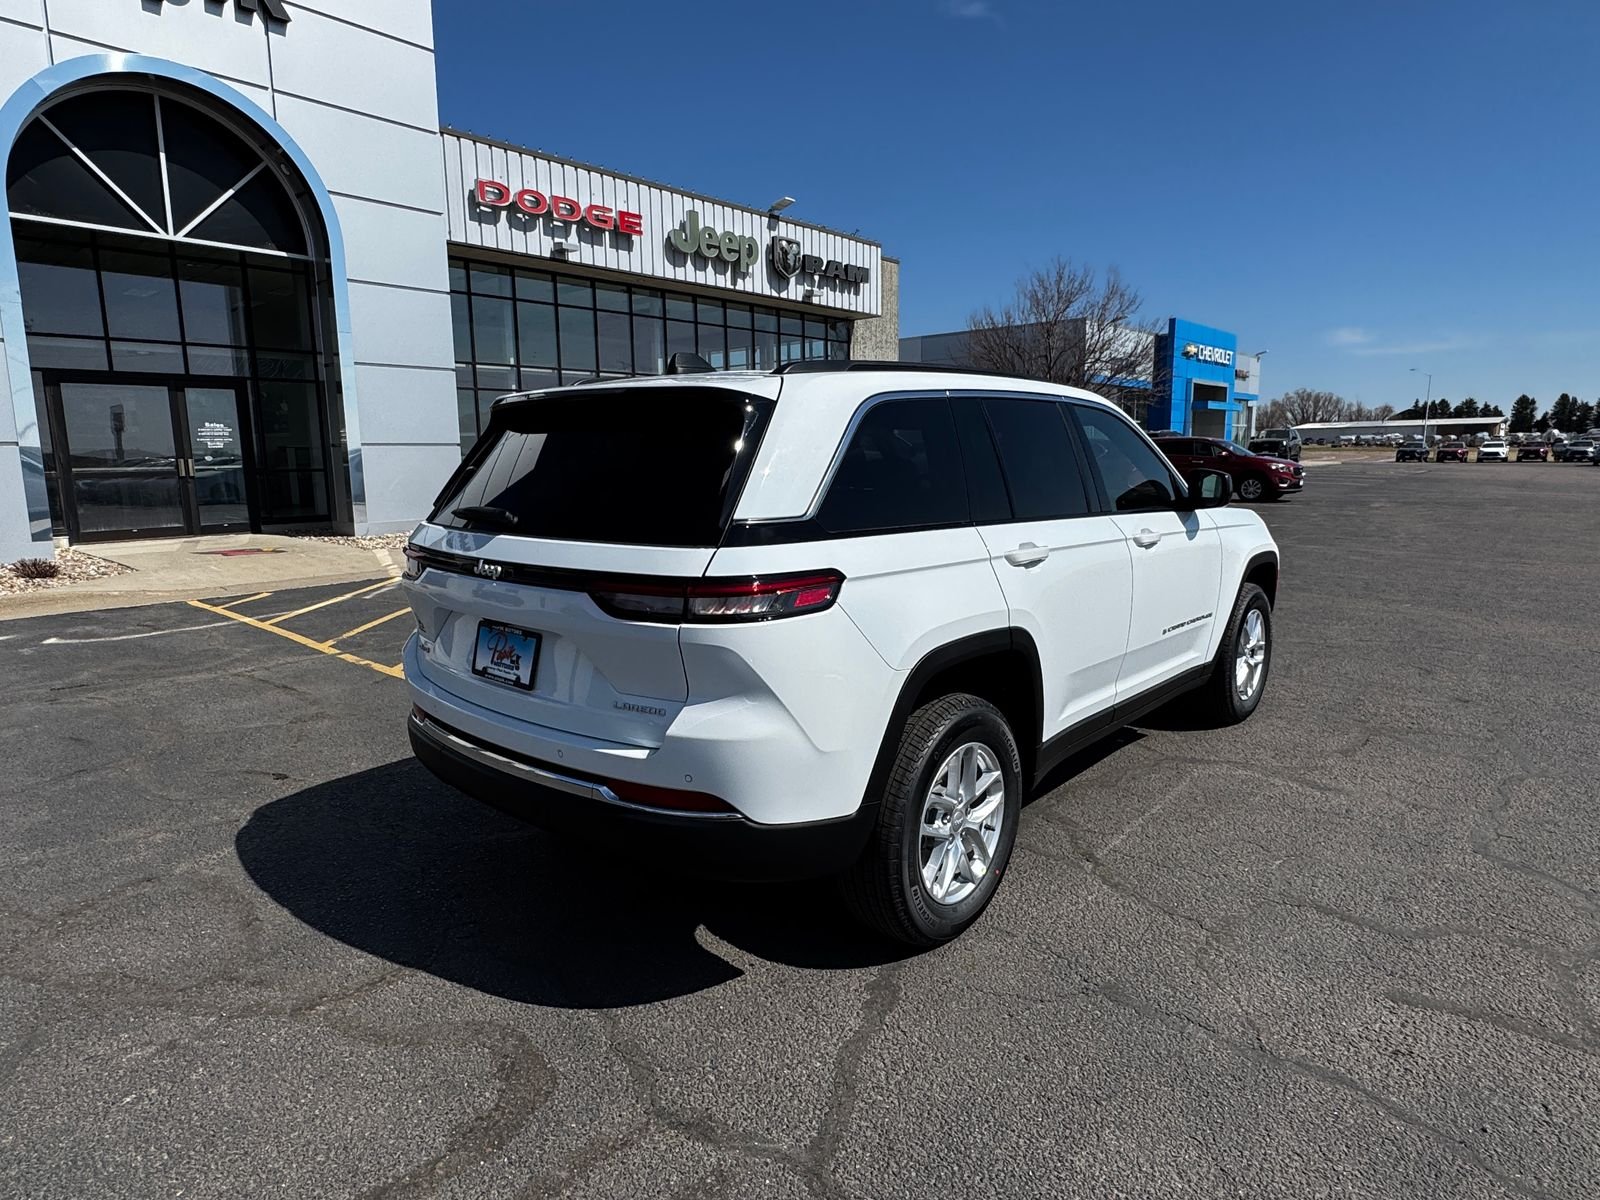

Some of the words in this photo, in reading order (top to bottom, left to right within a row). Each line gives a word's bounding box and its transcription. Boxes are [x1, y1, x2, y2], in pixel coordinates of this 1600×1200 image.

[476, 178, 643, 236] DODGE
[669, 210, 759, 272] Jeep
[802, 254, 869, 283] RAM
[1198, 345, 1233, 365] CHEVROLET
[473, 559, 502, 580] Jeep
[613, 701, 667, 717] LAREDO
